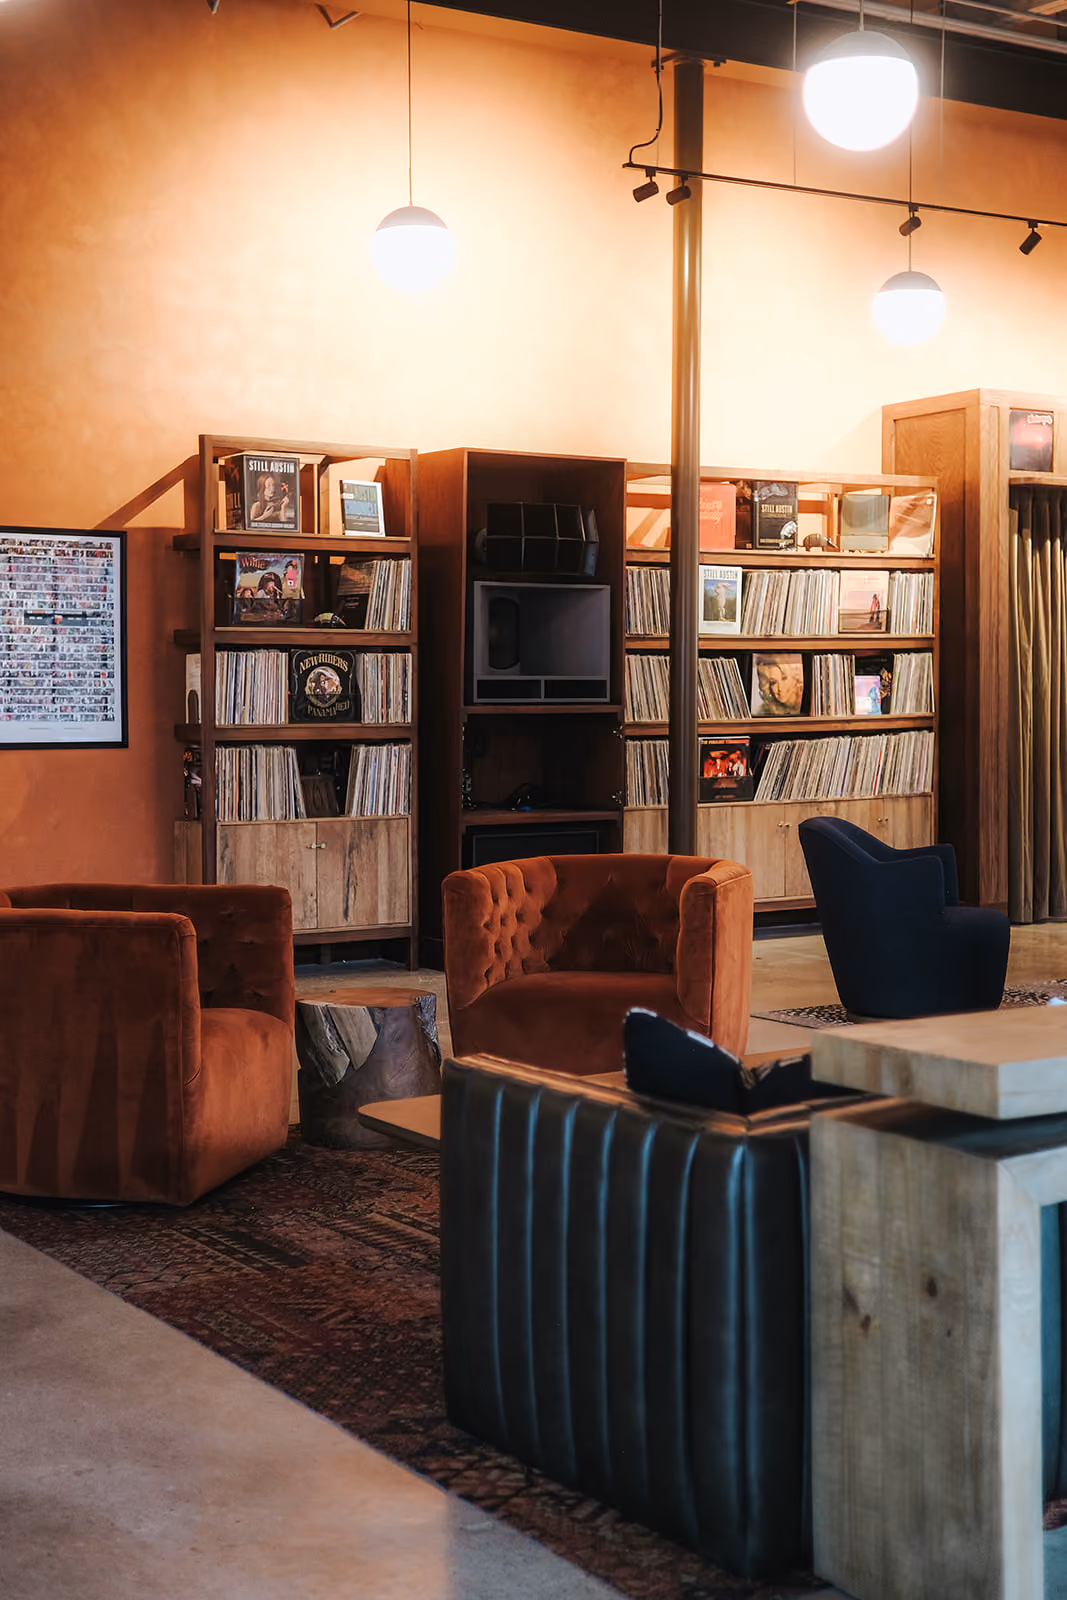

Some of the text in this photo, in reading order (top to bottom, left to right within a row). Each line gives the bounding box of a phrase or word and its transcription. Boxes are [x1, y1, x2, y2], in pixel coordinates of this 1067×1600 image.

[249, 460, 295, 474] STILL AUSTIN
[761, 504, 775, 513] STILL
[703, 568, 718, 579] STILL
[299, 653, 349, 674] NEW RIDERS
